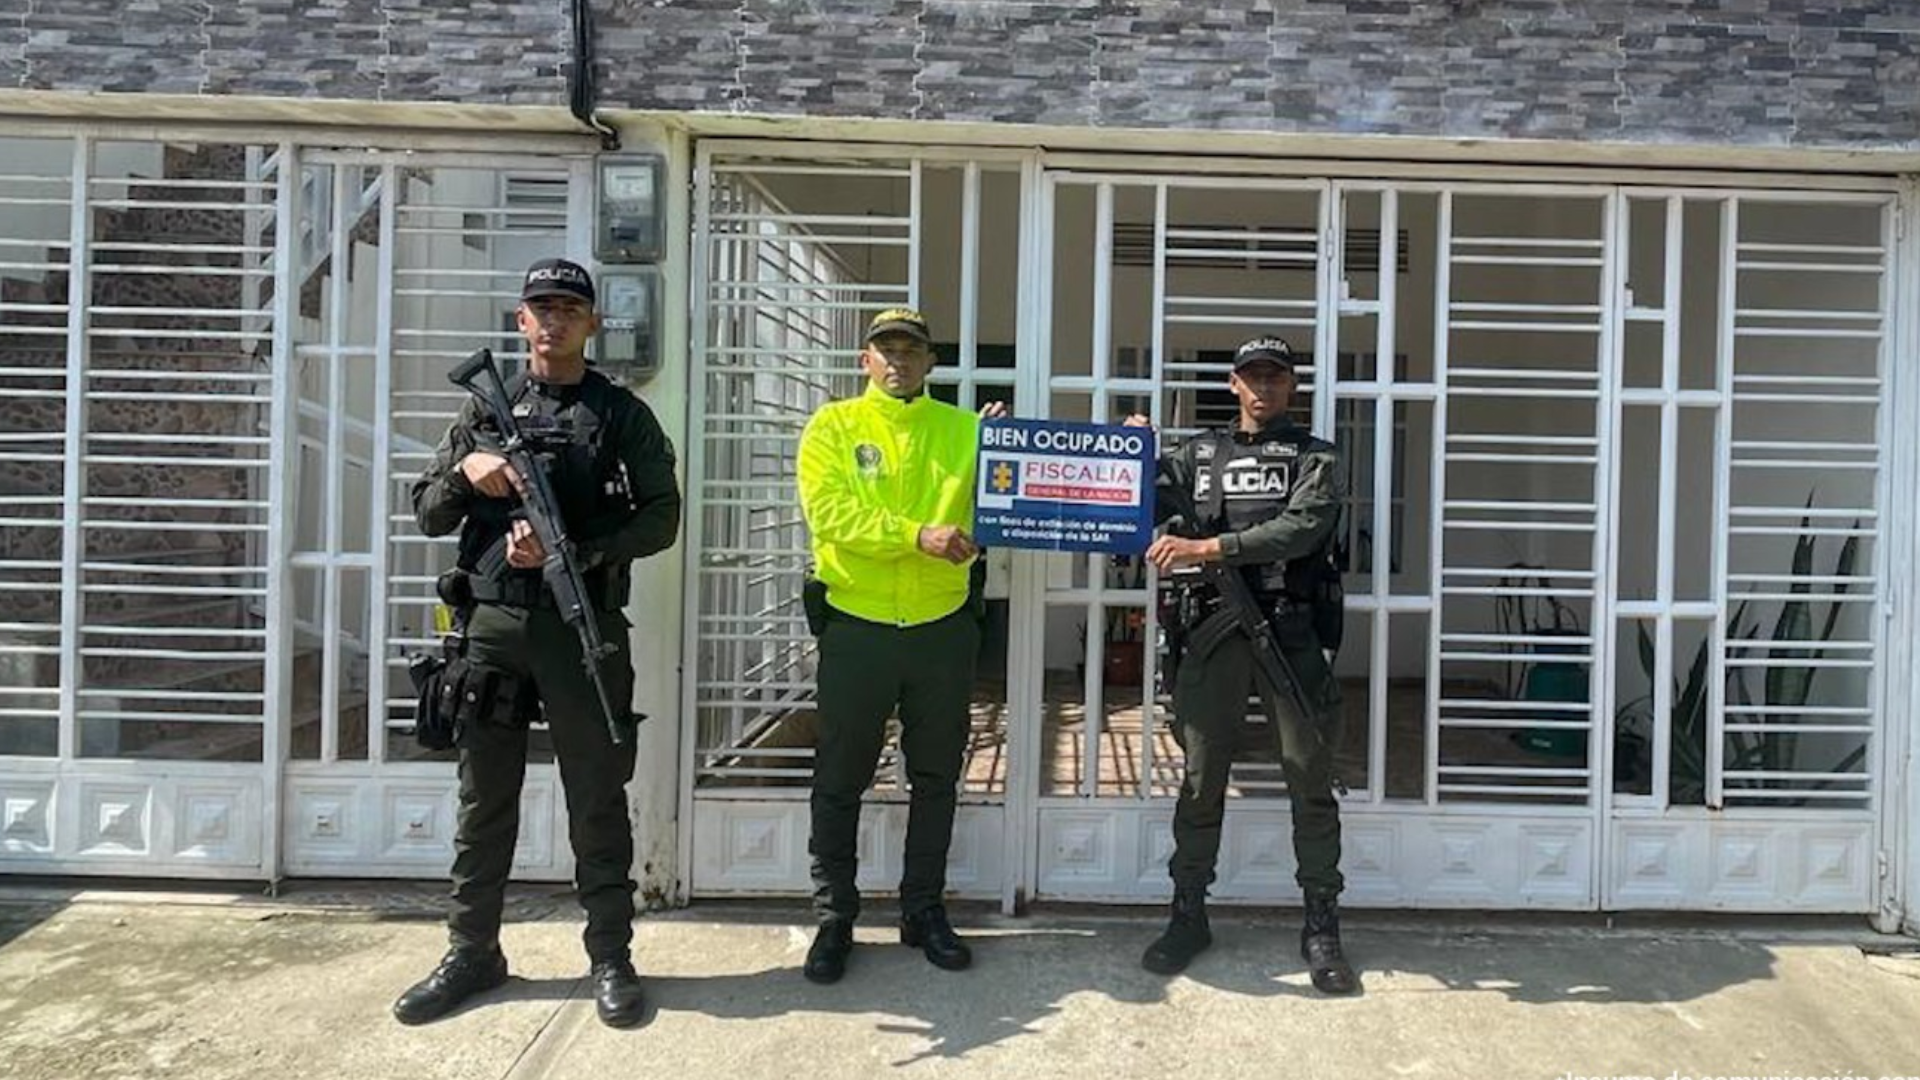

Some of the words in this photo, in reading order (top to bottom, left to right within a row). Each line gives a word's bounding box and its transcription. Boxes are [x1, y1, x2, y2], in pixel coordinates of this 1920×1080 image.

[982, 427, 1028, 447] BIEN
[1033, 430, 1143, 454] OCUPADO
[1025, 461, 1132, 483] FISCALÍA
[1198, 464, 1283, 493] PLICÍA
[1068, 487, 1080, 497] DE
